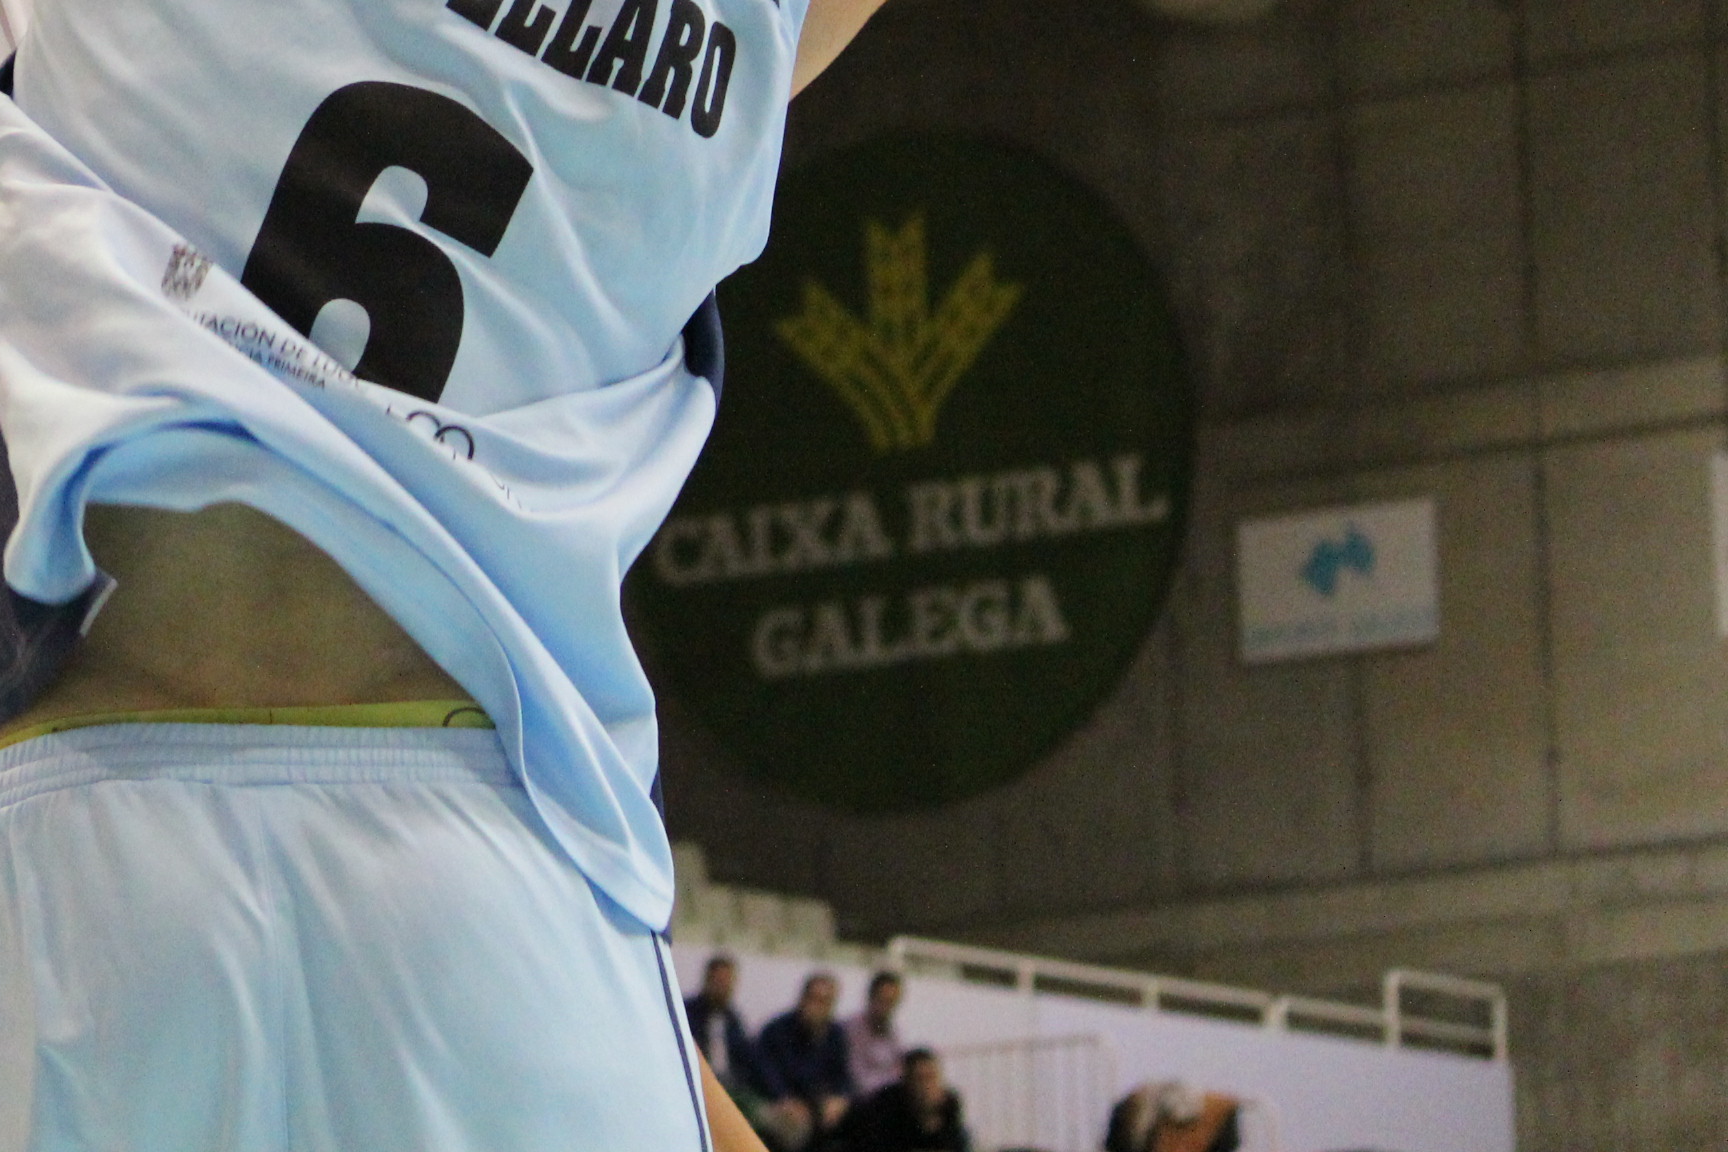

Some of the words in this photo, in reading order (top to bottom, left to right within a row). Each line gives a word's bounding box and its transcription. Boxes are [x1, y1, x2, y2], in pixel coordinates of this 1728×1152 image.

[241, 80, 535, 403] 6
[652, 489, 897, 588] CAIXA
[907, 454, 1170, 550] RURAL
[753, 574, 1070, 679] GALEGA
